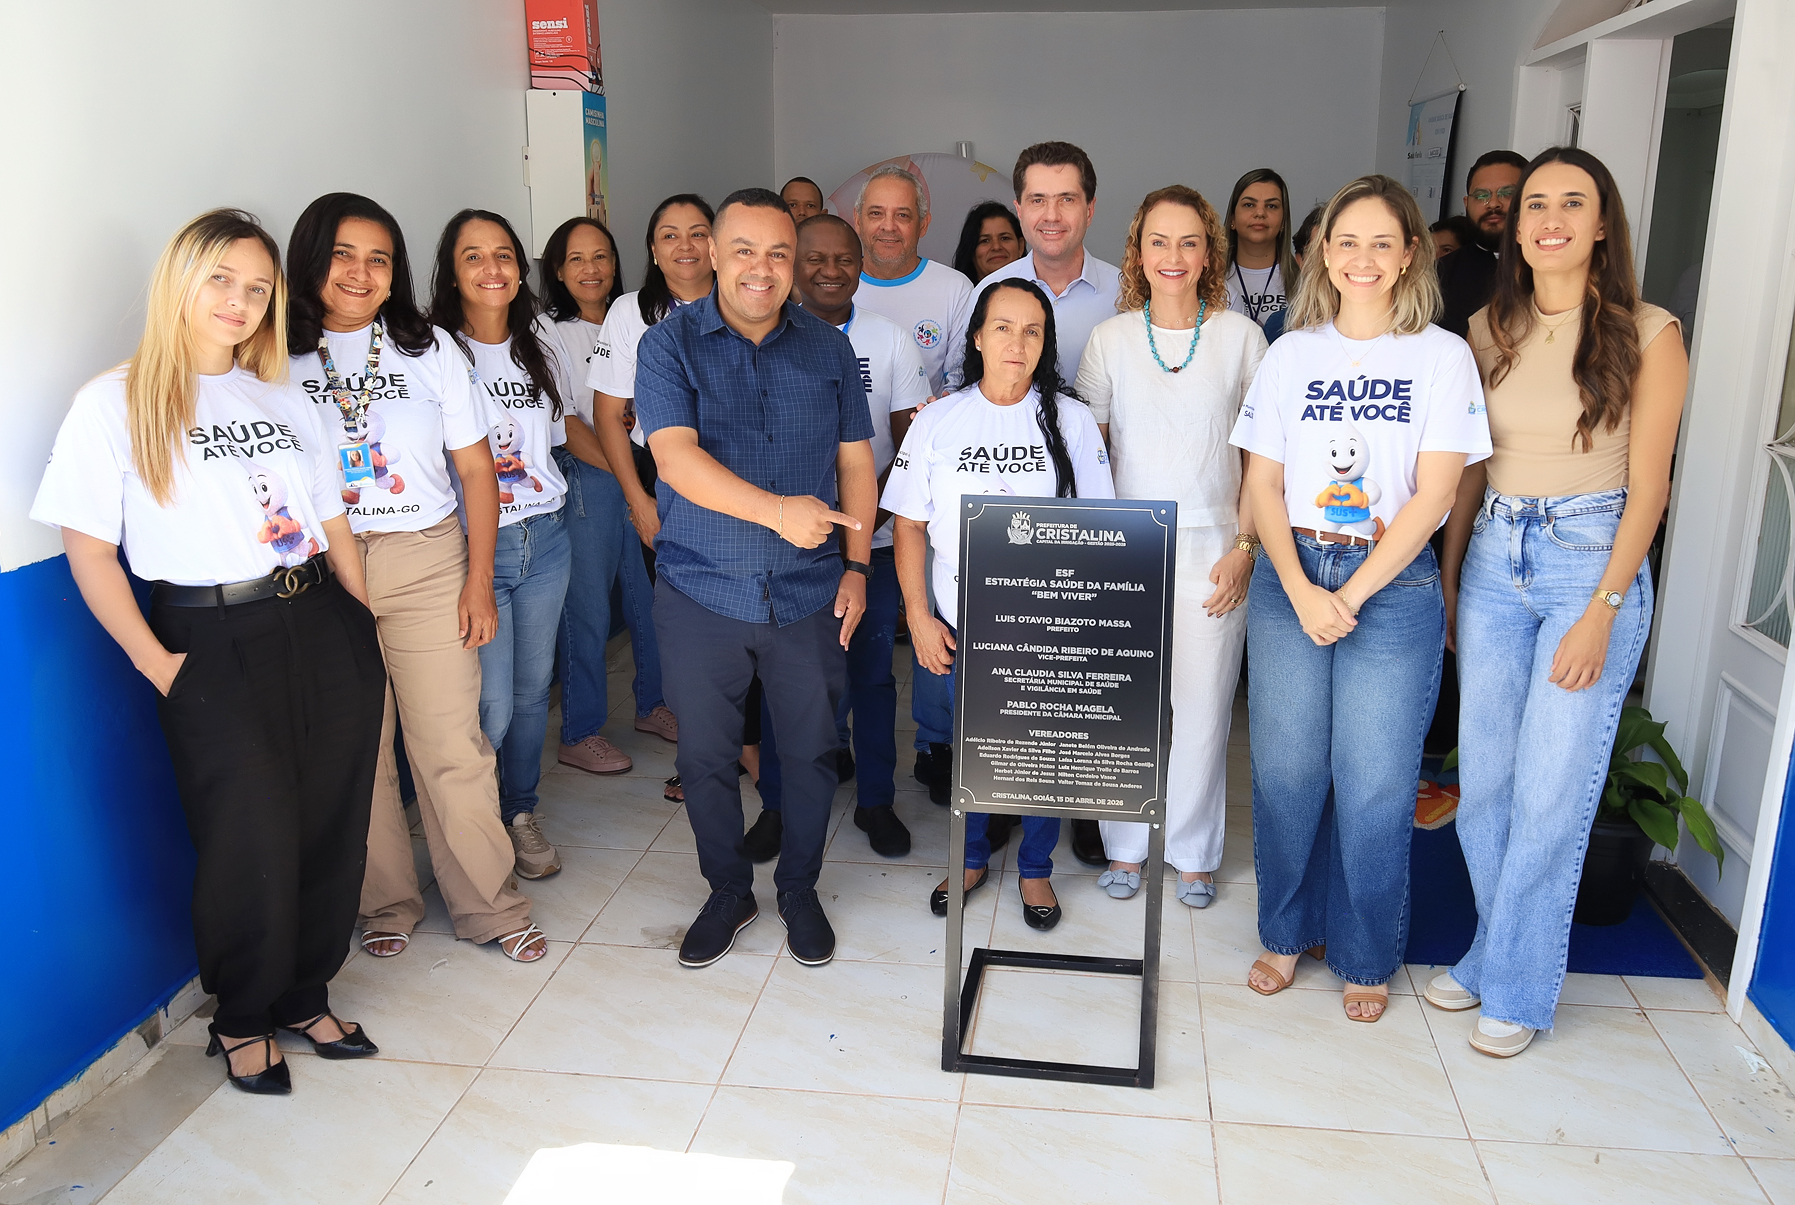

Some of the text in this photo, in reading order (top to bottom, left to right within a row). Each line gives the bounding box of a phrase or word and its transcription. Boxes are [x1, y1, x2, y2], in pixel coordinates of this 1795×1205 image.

[532, 18, 568, 30] sensi
[1241, 292, 1286, 305] ÚDE
[593, 344, 610, 358] ÚDE
[1305, 375, 1412, 401] SAÚDE
[1301, 401, 1411, 423] ATÉ VOCÊ
[189, 420, 297, 444] SAÚDE
[204, 438, 304, 460] ATÉ VOCÊ
[959, 443, 1044, 461] SAÚDE
[895, 457, 909, 470] DE
[956, 460, 1046, 473] ATÉ VOCÊ
[346, 504, 420, 515] TALINA-GO
[1036, 528, 1126, 542] CRISTALINA
[1056, 569, 1074, 577] ESF
[985, 577, 1145, 592] ESTRATÉGIA SAÚDE DA FAMÍLIA
[996, 615, 1131, 628] LUIS OTAVIO BIAZOTO MASSA
[973, 642, 1154, 658] LUCIANA CÂNDIDA RIBEIRO DE AQUINO
[991, 668, 1132, 682] ANA CLAUDIA SILVA FERREIRA
[1004, 676, 1045, 685] SECRETÁRIA
[1096, 680, 1119, 688] SAÚDE
[1027, 684, 1066, 694] VIGILÂNCIA
[1079, 686, 1102, 695] SAÚDE
[1007, 701, 1114, 714] PABLO ROCHA MAGELA
[1054, 711, 1083, 719] CÂMARA
[1029, 730, 1089, 740] VEREADORES
[1003, 754, 1030, 762] Rodrigues
[992, 792, 1032, 801] CRISTALINA,
[1033, 793, 1055, 803] GOIÁS,
[1076, 796, 1095, 804] ABRIL
